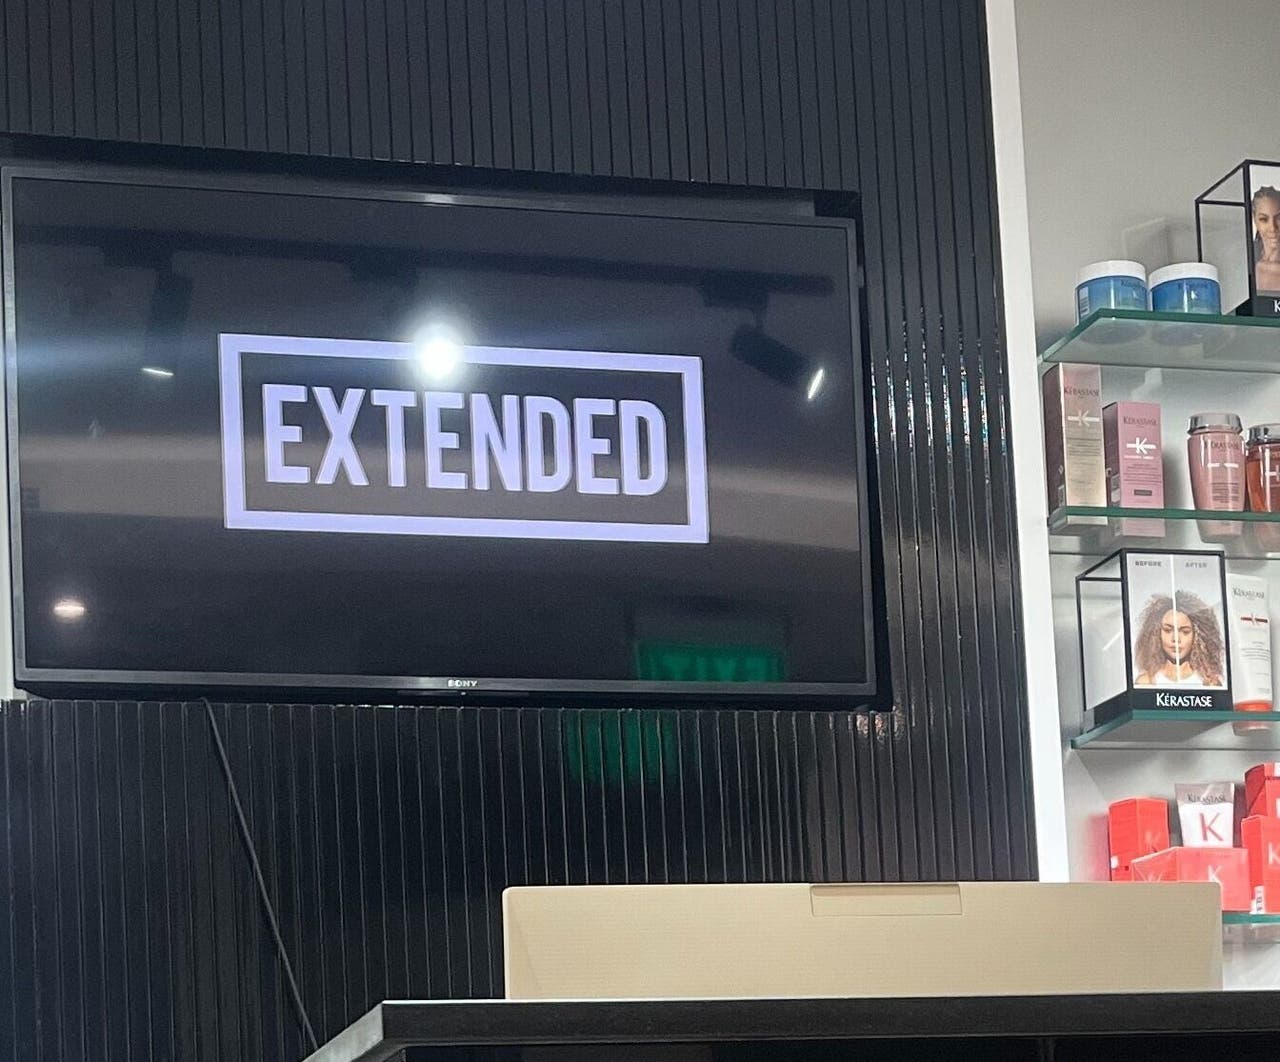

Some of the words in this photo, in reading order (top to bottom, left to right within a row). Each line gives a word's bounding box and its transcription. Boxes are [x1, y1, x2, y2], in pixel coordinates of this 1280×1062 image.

[262, 382, 668, 498] EXTENDED
[1156, 693, 1213, 708] KÉRASTASE
[1199, 812, 1224, 843] K
